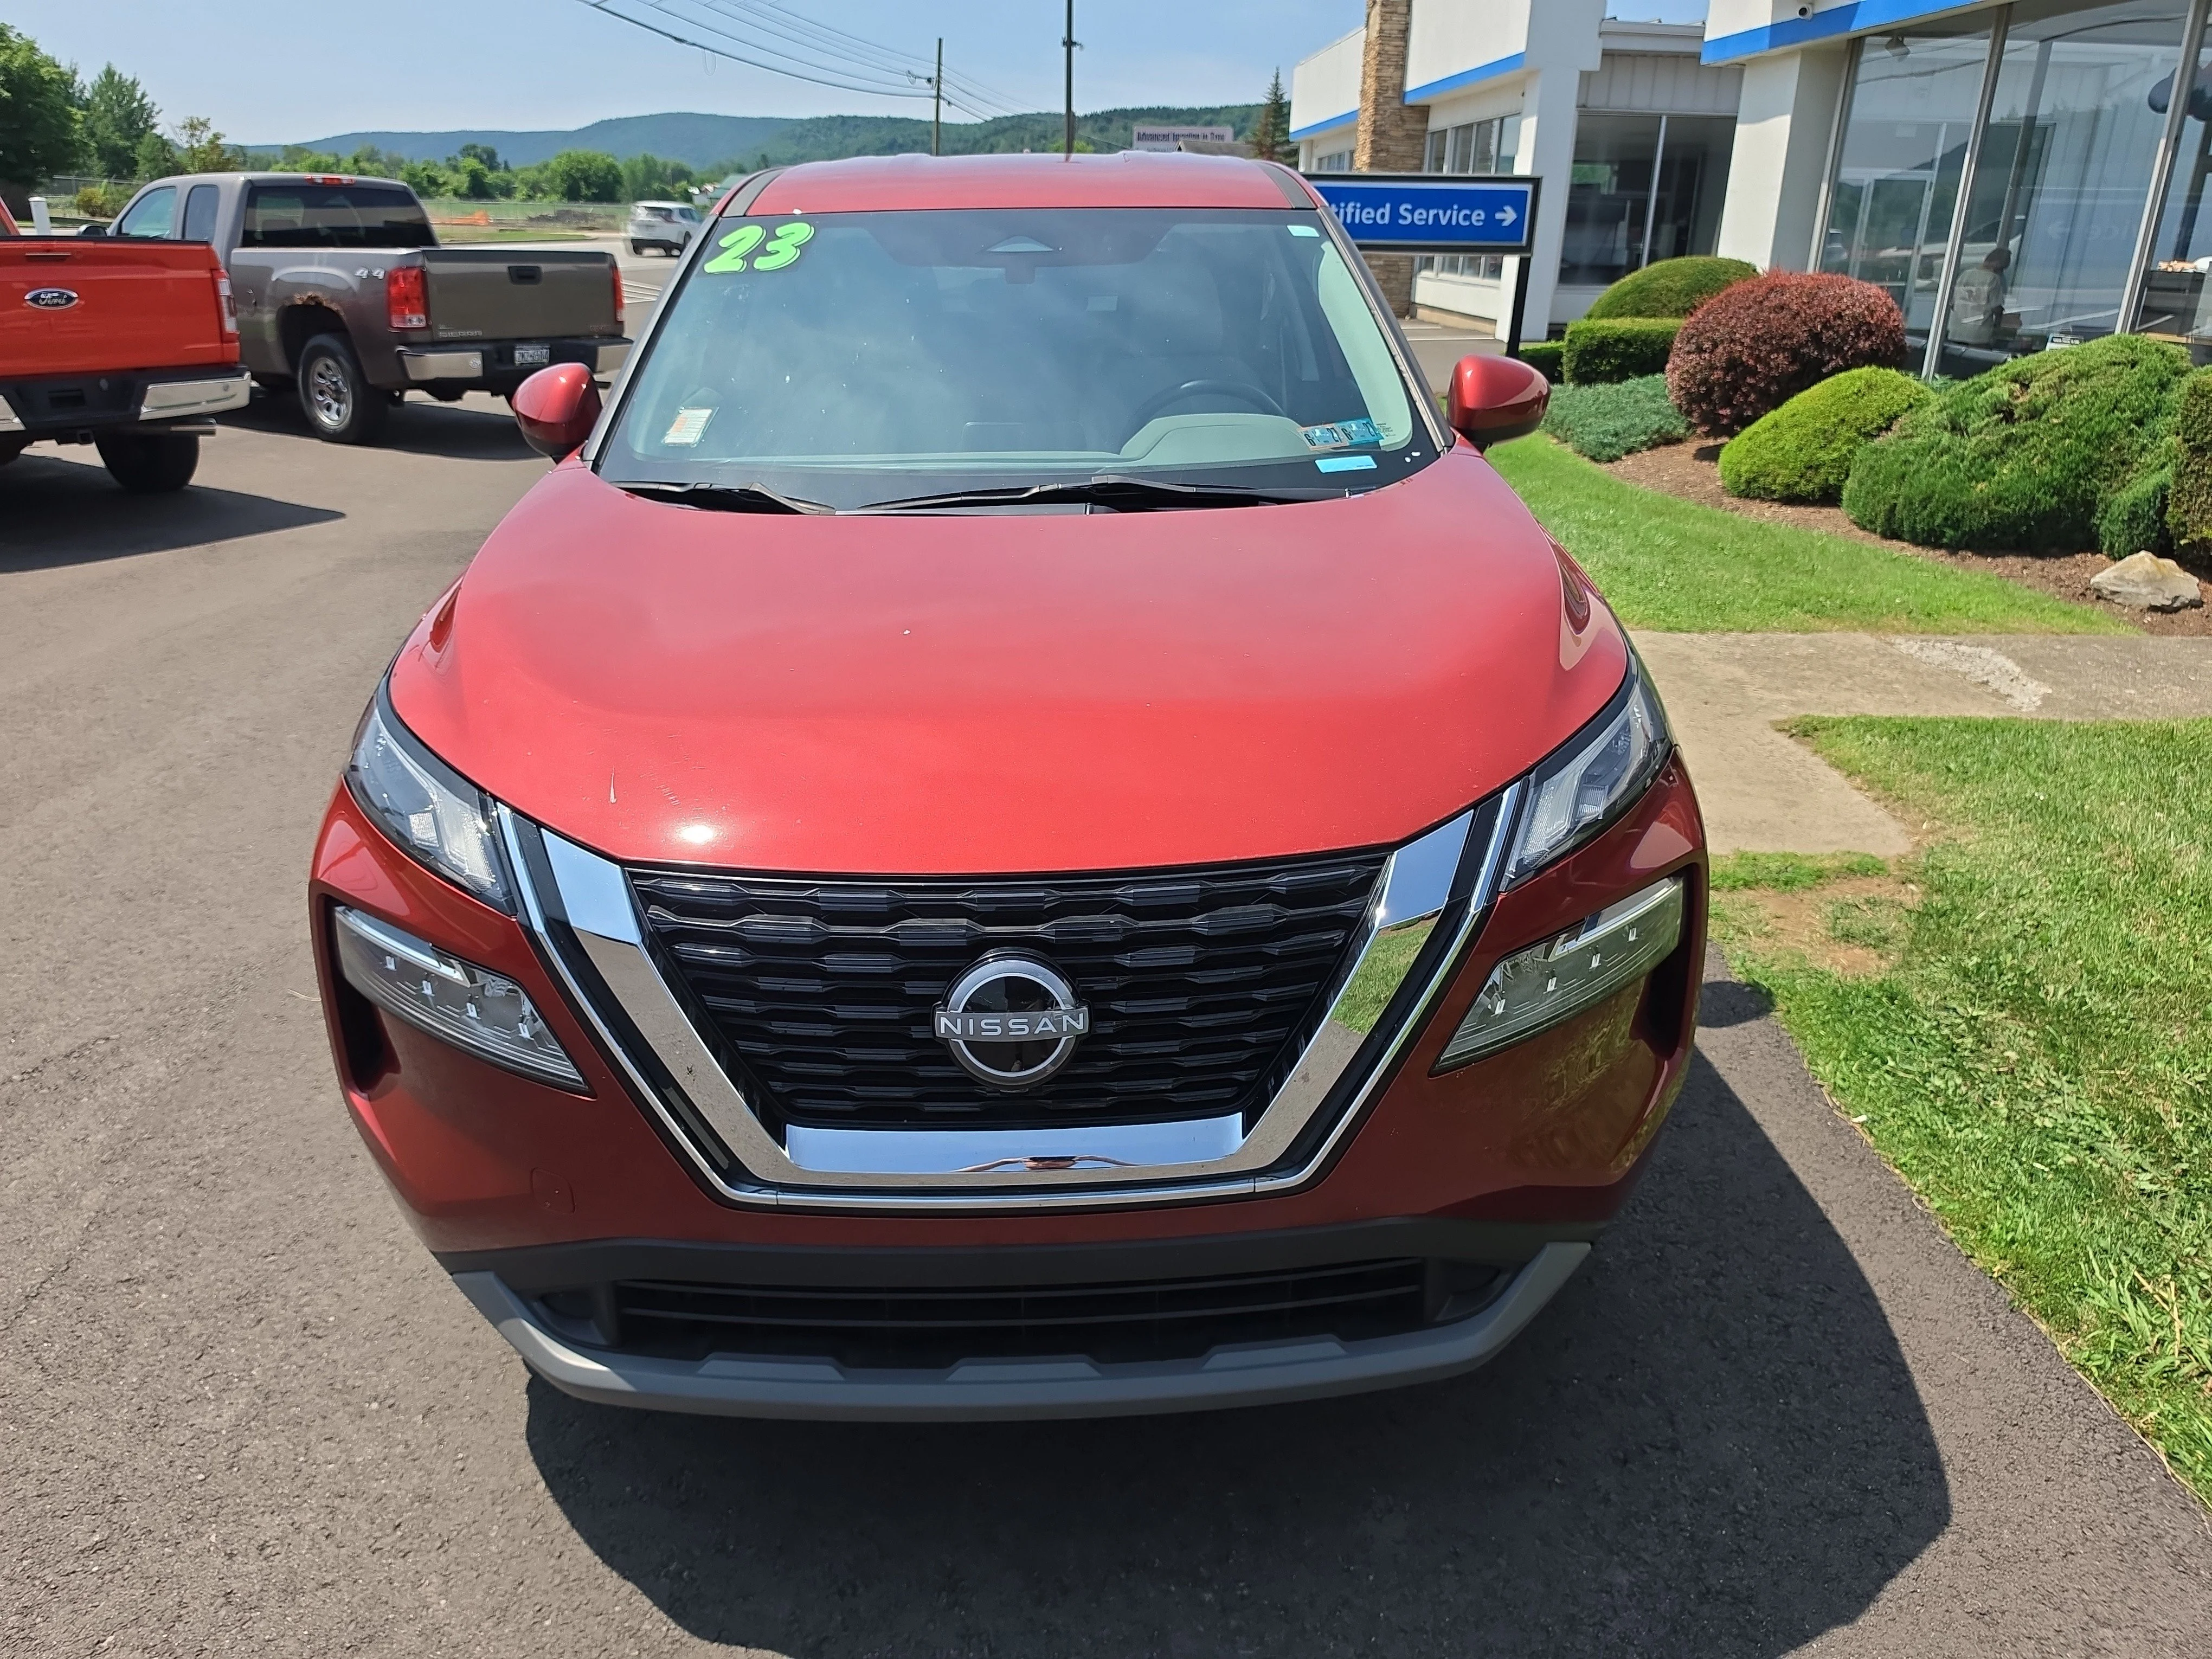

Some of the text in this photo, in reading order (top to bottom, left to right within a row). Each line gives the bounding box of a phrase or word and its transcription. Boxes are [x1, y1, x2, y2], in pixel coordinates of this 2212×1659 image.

[1398, 203, 1486, 226] Service
[703, 222, 815, 274] 23
[38, 293, 67, 305] Ford
[1304, 427, 1342, 446] 6 27
[1341, 428, 1354, 440] 6
[1362, 422, 1378, 437] 27
[939, 1012, 1084, 1036] NISSAN
